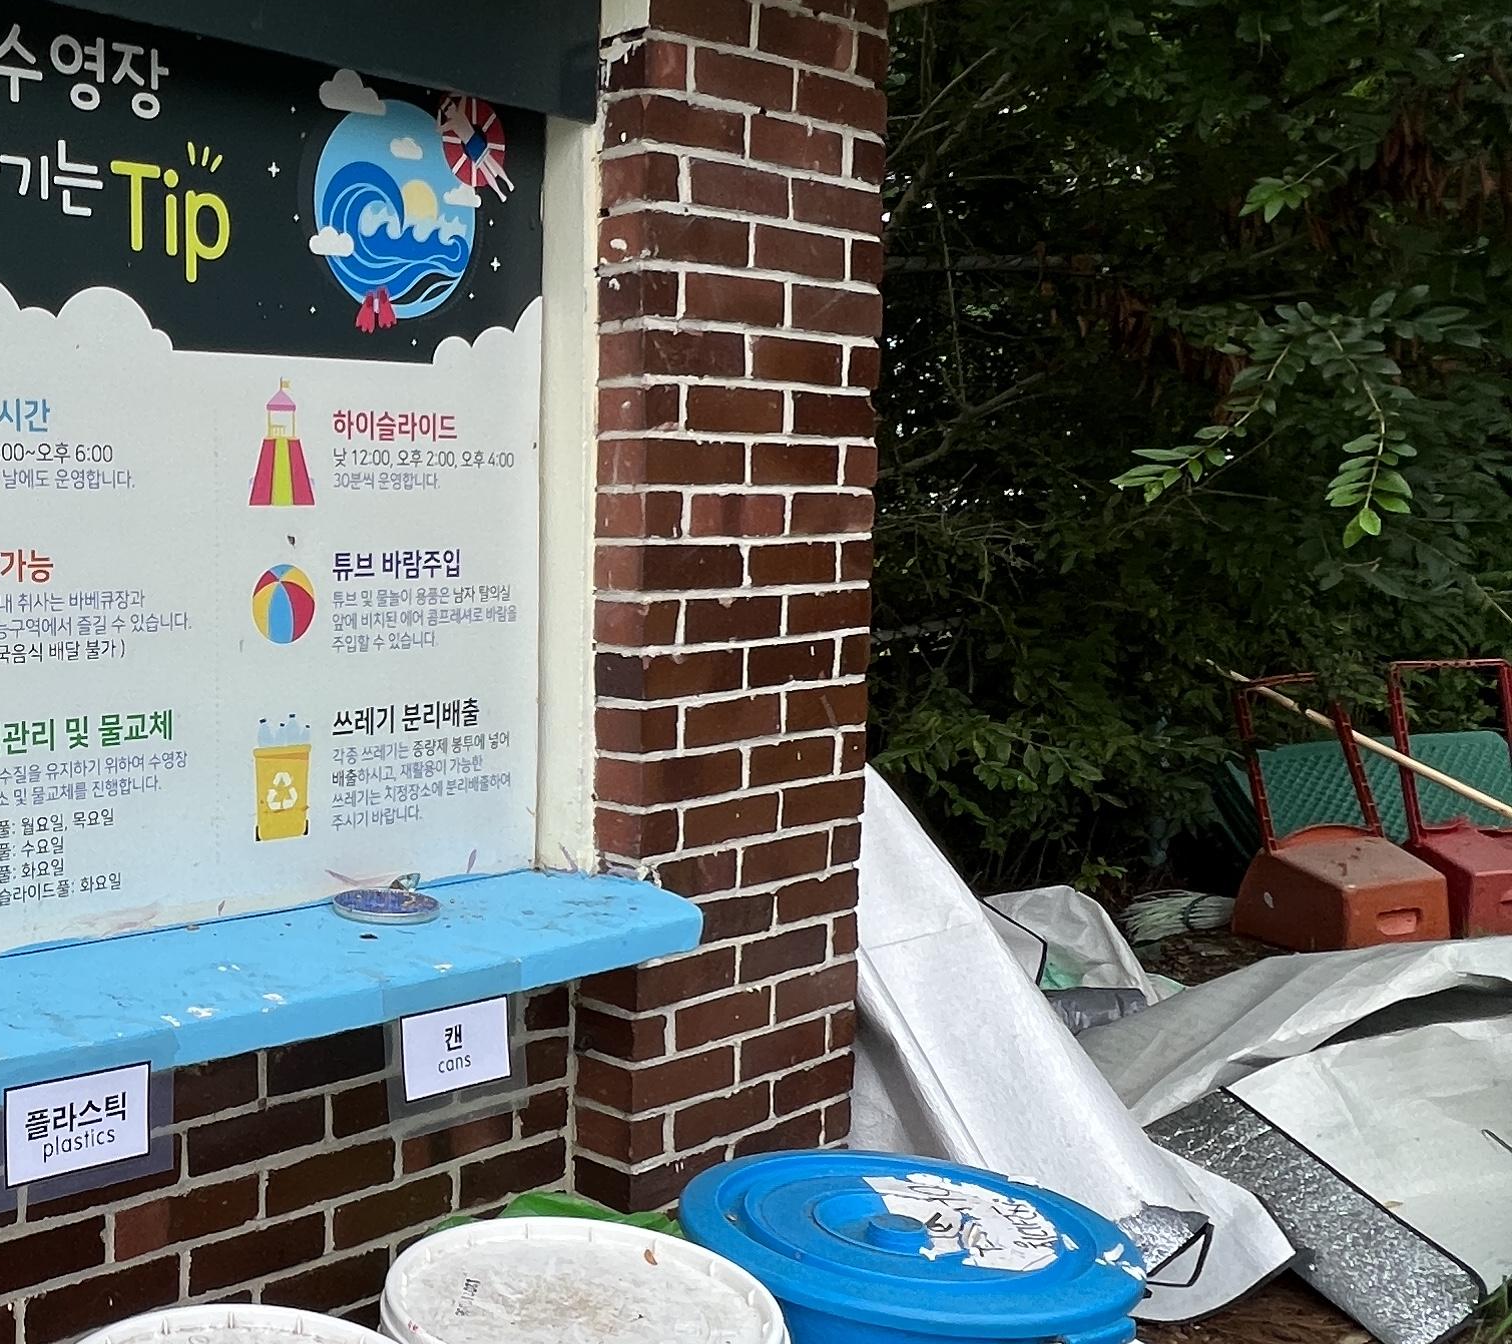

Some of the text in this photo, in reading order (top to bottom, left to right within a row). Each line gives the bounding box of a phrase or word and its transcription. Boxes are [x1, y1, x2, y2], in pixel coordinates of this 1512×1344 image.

[333, 410, 458, 442] 하이슬라이드
[75, 444, 112, 462] 6:00
[333, 449, 514, 469] 낮 12:00, 오후 2:00, 오후 4:00
[2, 468, 49, 488] 날에도
[54, 468, 135, 489] 운영합니다.
[334, 473, 440, 490] 30분씩 운영합니다.
[333, 548, 461, 582] 튜브 바람주입
[18, 592, 64, 612] 취사는
[69, 590, 145, 611] 바베큐장과
[333, 584, 511, 609] 튜브 및 물놀이 용품은 남자 탈의실
[77, 616, 106, 636] 즐길
[111, 615, 125, 634] 수
[130, 612, 192, 633] 있습니다.
[332, 611, 358, 631] 앞에
[361, 610, 397, 629] 비치된
[400, 610, 424, 627] 에어
[486, 605, 517, 623] 바람을
[49, 640, 80, 661] 배달
[332, 632, 370, 653] 주입할
[372, 633, 384, 651] 수
[66, 717, 88, 748] 및
[98, 709, 174, 747] 물교체
[332, 698, 480, 736] 쓰레기 분리배출
[332, 731, 510, 765] 각종 쓰레기는 종량제 봉투에 넣어
[45, 759, 101, 780] 유지하기
[105, 755, 145, 775] 위하여
[148, 751, 188, 770] 수영장
[400, 759, 447, 780] 재활용이
[450, 755, 483, 774] 가능한
[13, 788, 27, 806] 및
[31, 782, 87, 805] 물교체를
[92, 775, 162, 799] 진행합니다.
[332, 772, 511, 810] 쓰레기는 지정장소에 분리배출하여
[21, 813, 68, 837] 월요일,
[73, 808, 114, 828] 목요일
[332, 804, 422, 831] 주시기 바랍니다.
[21, 836, 65, 857] 수요일
[21, 858, 65, 880] 화요일
[80, 872, 121, 894] 화요일
[445, 1024, 462, 1051] 캔
[438, 1055, 471, 1073] cans
[25, 1091, 126, 1141] 플라스틱
[43, 1129, 115, 1163] plastics
